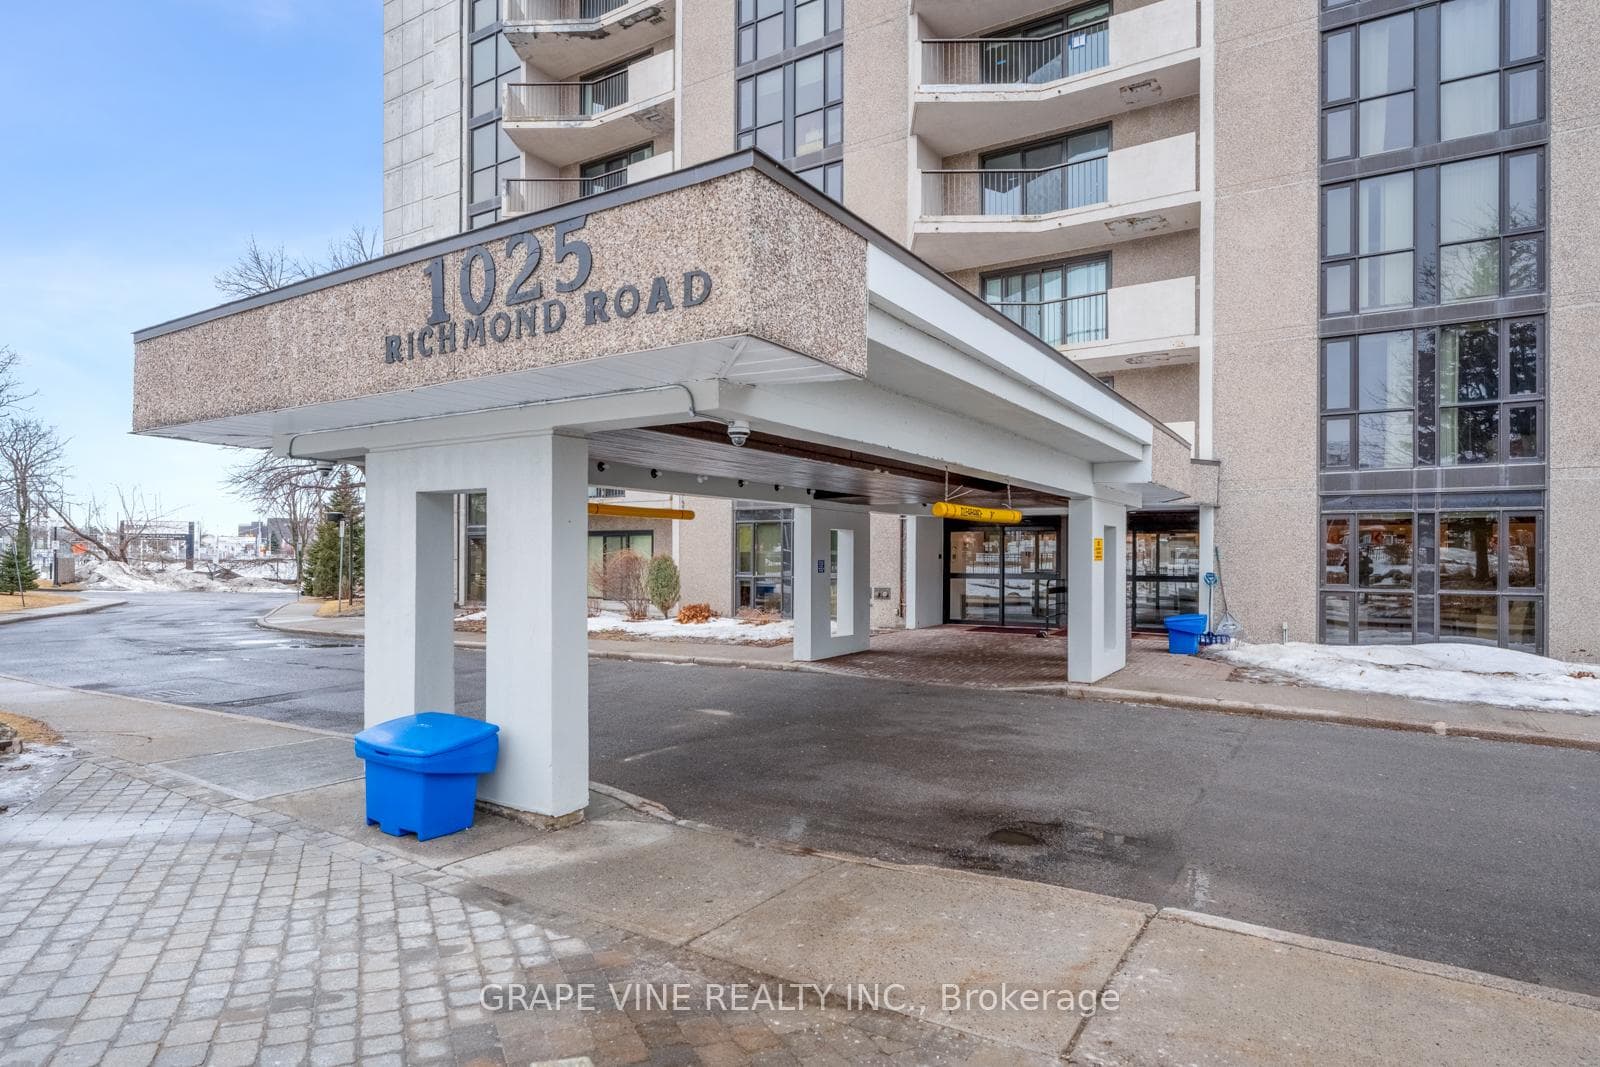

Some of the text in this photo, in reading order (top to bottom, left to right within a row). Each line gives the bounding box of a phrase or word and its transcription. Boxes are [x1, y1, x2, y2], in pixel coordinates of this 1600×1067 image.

[385, 269, 713, 364] RICHMOND ROAD
[423, 213, 593, 326] 1025
